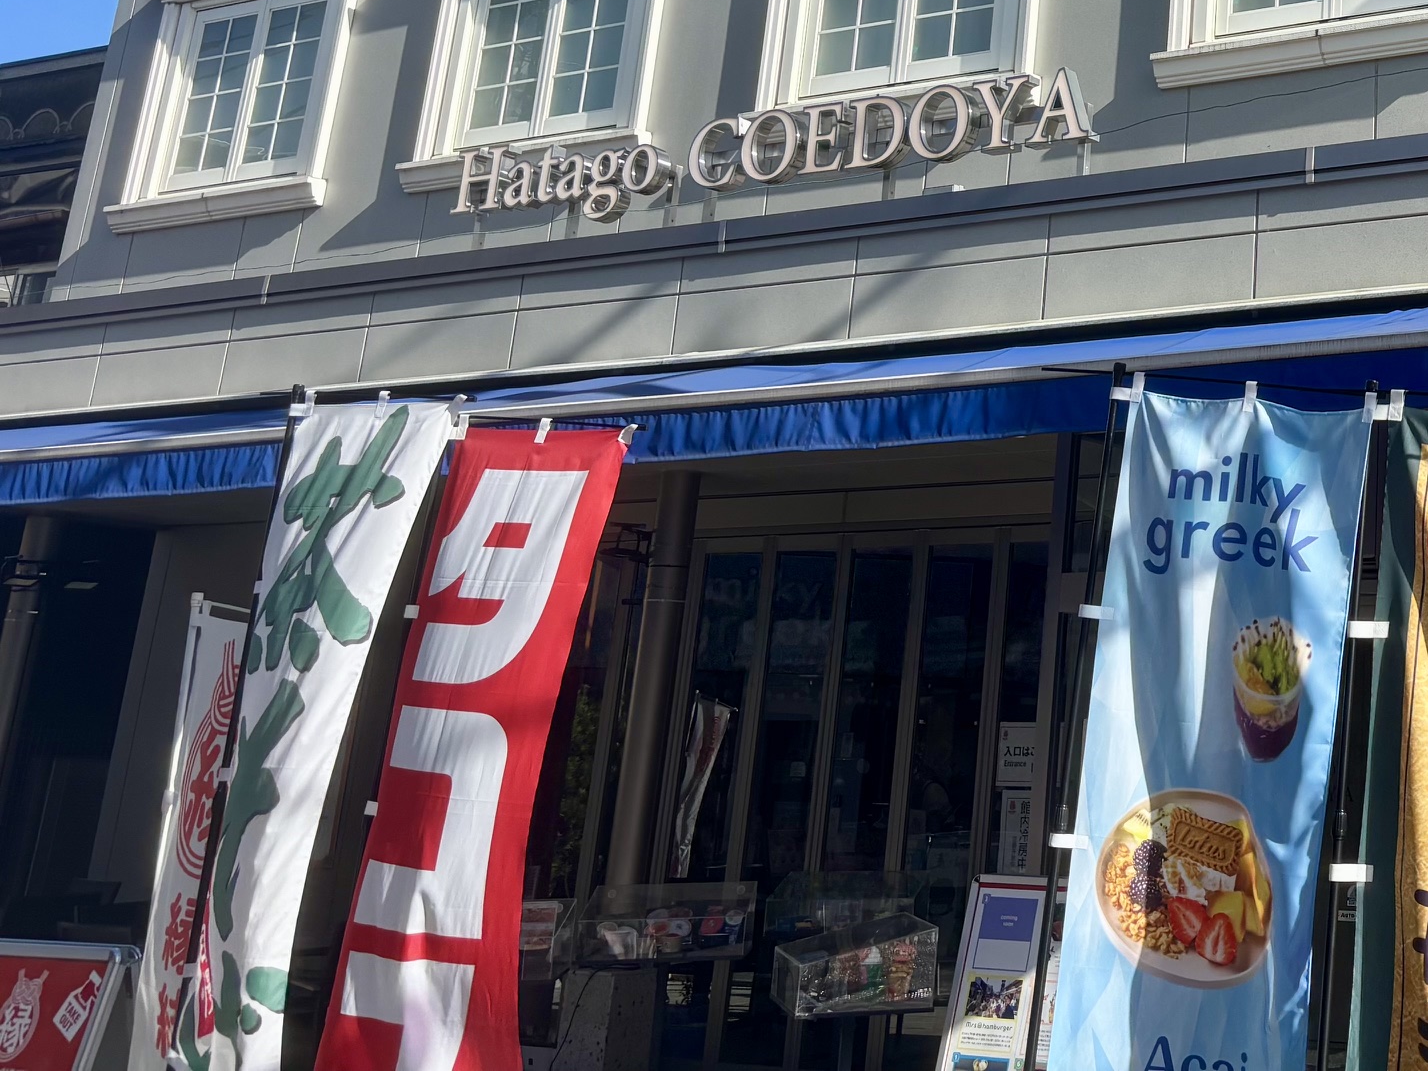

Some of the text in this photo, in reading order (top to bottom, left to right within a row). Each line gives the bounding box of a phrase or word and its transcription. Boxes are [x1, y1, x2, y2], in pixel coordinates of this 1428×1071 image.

[450, 67, 1092, 222] Hatago COEDOYA
[1167, 452, 1306, 523] milky
[1143, 508, 1319, 574] greek
[59, 1014, 74, 1032] OUT
[65, 1002, 81, 1025] TAKE
